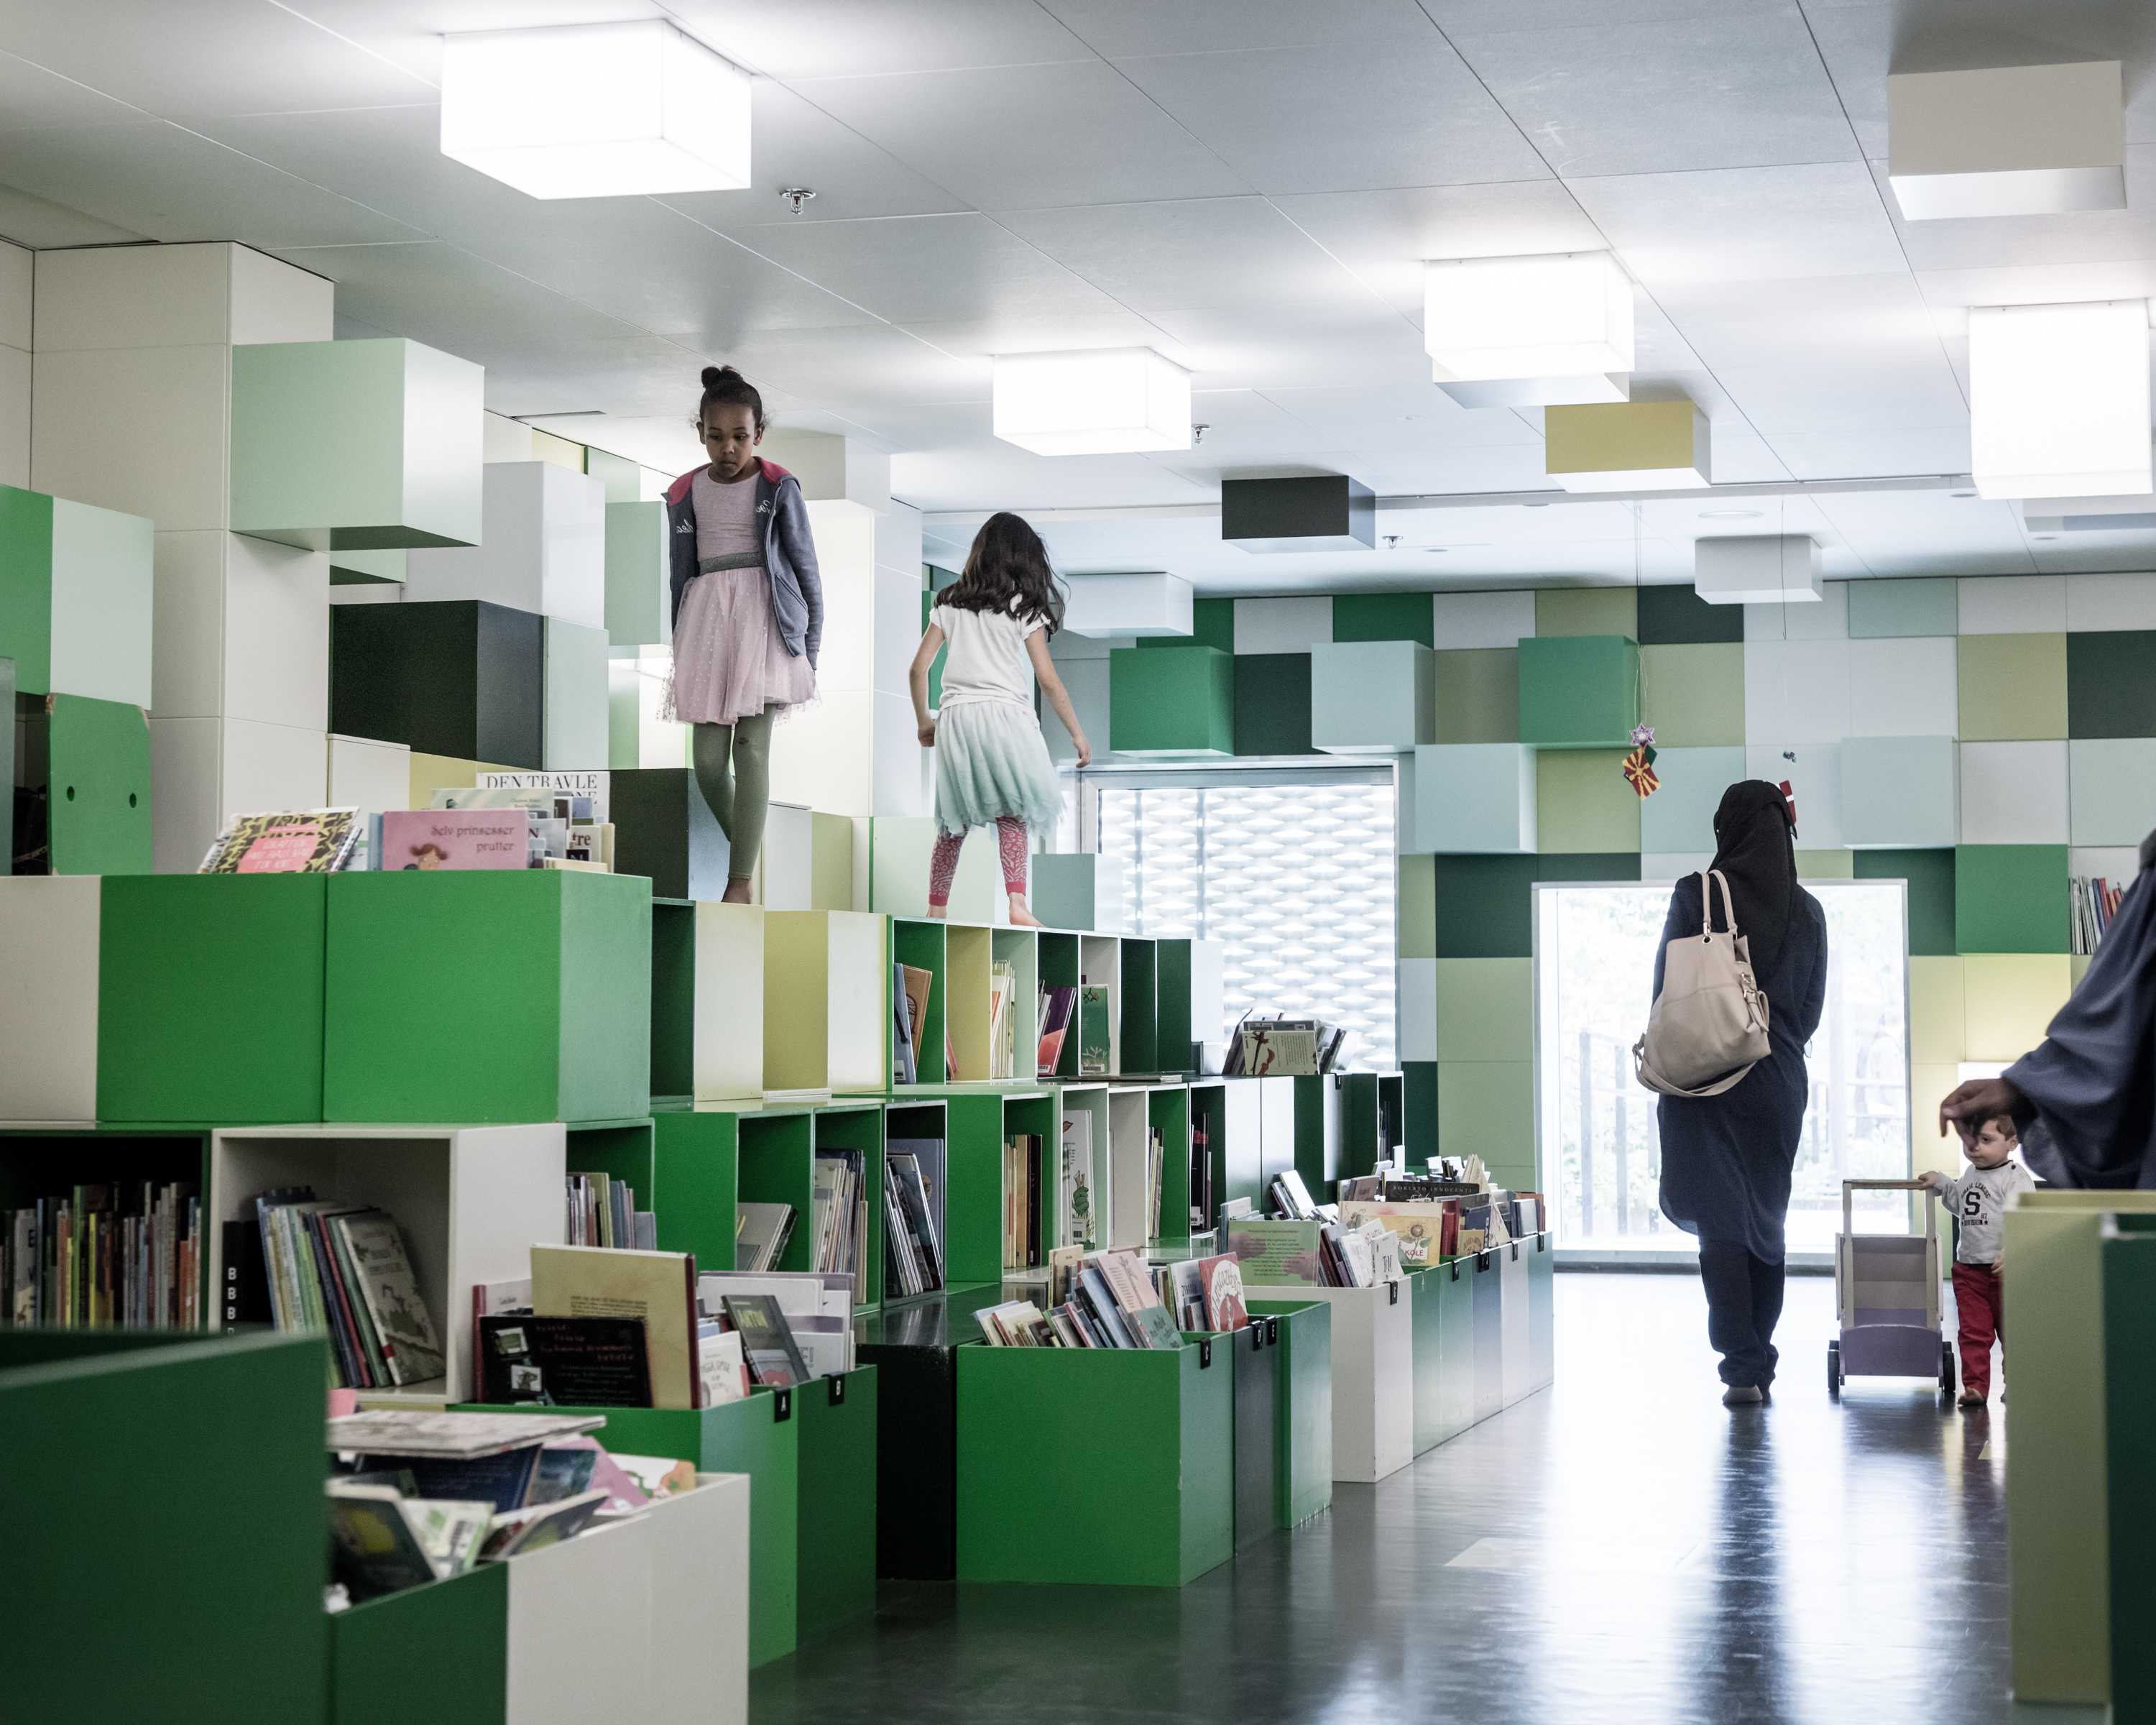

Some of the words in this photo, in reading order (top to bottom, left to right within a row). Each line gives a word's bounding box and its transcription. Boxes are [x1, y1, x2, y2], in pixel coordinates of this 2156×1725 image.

[487, 776, 522, 788] DEN
[527, 774, 598, 789] TRAVLE
[1964, 1190, 1981, 1216] S
[780, 1394, 787, 1412] A
